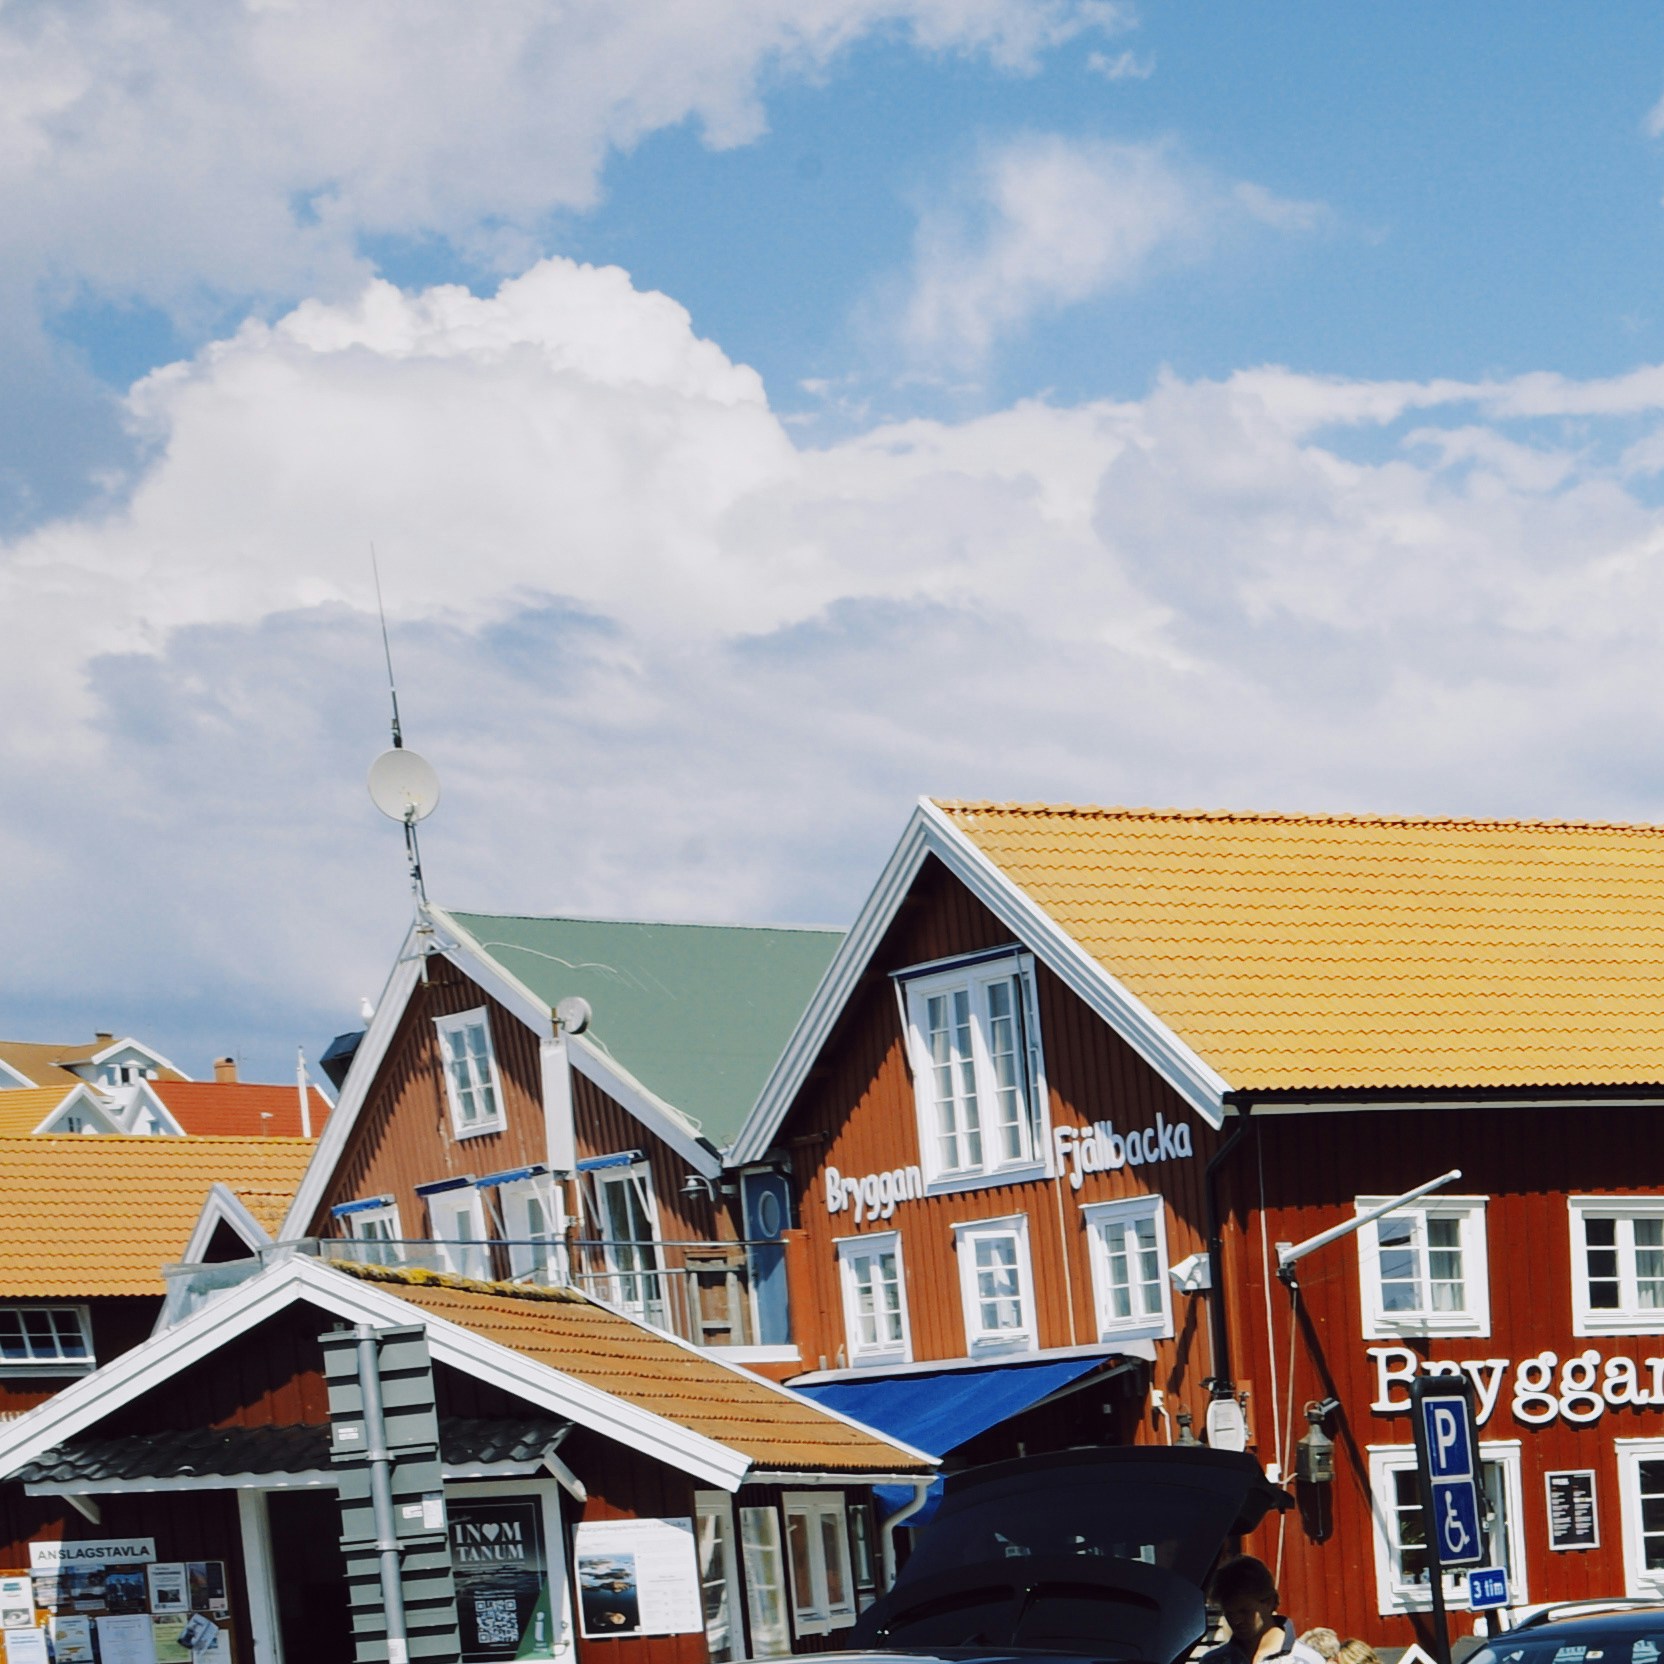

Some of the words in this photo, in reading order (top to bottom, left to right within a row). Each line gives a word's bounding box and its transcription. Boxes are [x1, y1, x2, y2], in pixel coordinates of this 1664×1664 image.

[824, 1165, 922, 1224] Bryggan
[1053, 1111, 1194, 1190] Fjällbacka
[1434, 1408, 1457, 1468] P
[37, 1545, 150, 1560] ANSLAGSTAVLA
[455, 1544, 525, 1562] TANUM
[1473, 1581, 1482, 1599] 3
[1484, 1579, 1504, 1597] tim
